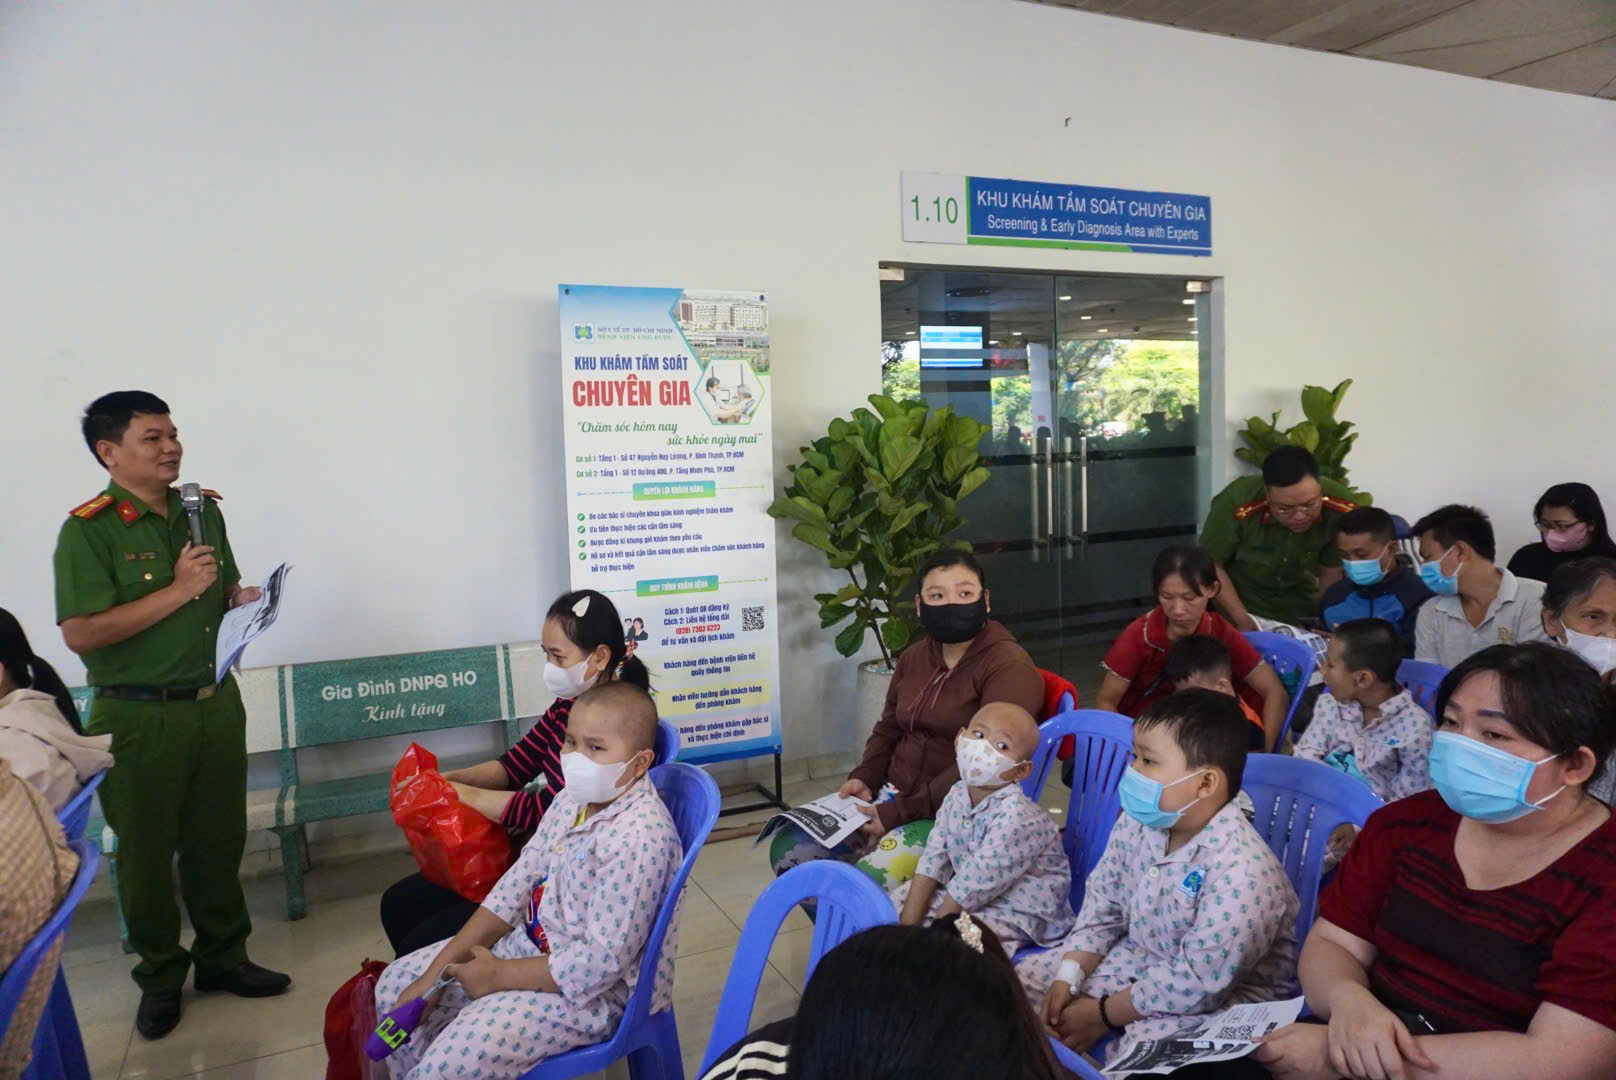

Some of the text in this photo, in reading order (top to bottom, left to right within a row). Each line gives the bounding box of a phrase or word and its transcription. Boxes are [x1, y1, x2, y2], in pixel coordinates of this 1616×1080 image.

[912, 194, 958, 223] 1.10
[978, 190, 1008, 207] KHU
[1013, 191, 1053, 210] KHÁM
[1091, 196, 1125, 214] SOÁT
[1129, 201, 1181, 218] CHUYÊN
[1185, 206, 1206, 220] GIA
[988, 214, 1198, 242] Screening & Early Diagnosis Area with Experts
[575, 356, 596, 370] KHU
[600, 354, 632, 370] KHÁM
[663, 354, 688, 370] SOÁT
[573, 374, 691, 407] CHUYÊN GIA
[615, 421, 631, 432] sóc
[633, 421, 656, 432] hôm
[658, 424, 677, 434] nay
[667, 435, 683, 446] sức
[712, 433, 736, 447] ngày
[626, 510, 645, 518] chuyên
[592, 564, 598, 572] hỗ
[665, 607, 678, 616] Cách
[686, 605, 698, 614] Quét
[700, 604, 706, 613] QR
[708, 603, 721, 612] đăng
[723, 602, 729, 611] ký
[664, 617, 678, 625] Cách
[686, 615, 698, 624] Liên
[699, 614, 706, 624] hệ
[707, 612, 719, 622] tổng
[721, 612, 729, 621] đài
[676, 627, 690, 635] (028)
[662, 637, 668, 646] Để
[678, 635, 688, 644] vấn
[690, 635, 696, 644] và
[698, 634, 707, 644] đặt
[708, 634, 718, 642] lịch
[720, 632, 734, 640] khám
[664, 652, 755, 669] Khách hàng đến bệnh viện liên hệ
[691, 668, 704, 677] quầy
[706, 667, 722, 676] thông
[322, 671, 477, 701] Gia Đình DNPQ HO
[672, 685, 762, 702] Nhân viên hướng dẫn khách hàng
[696, 697, 740, 709] đến phòng khám
[680, 725, 694, 734] hàng
[695, 723, 706, 732] đến
[707, 722, 724, 732] phòng
[742, 718, 752, 726] gặp
[688, 728, 745, 743] và thực hiện chỉ định
